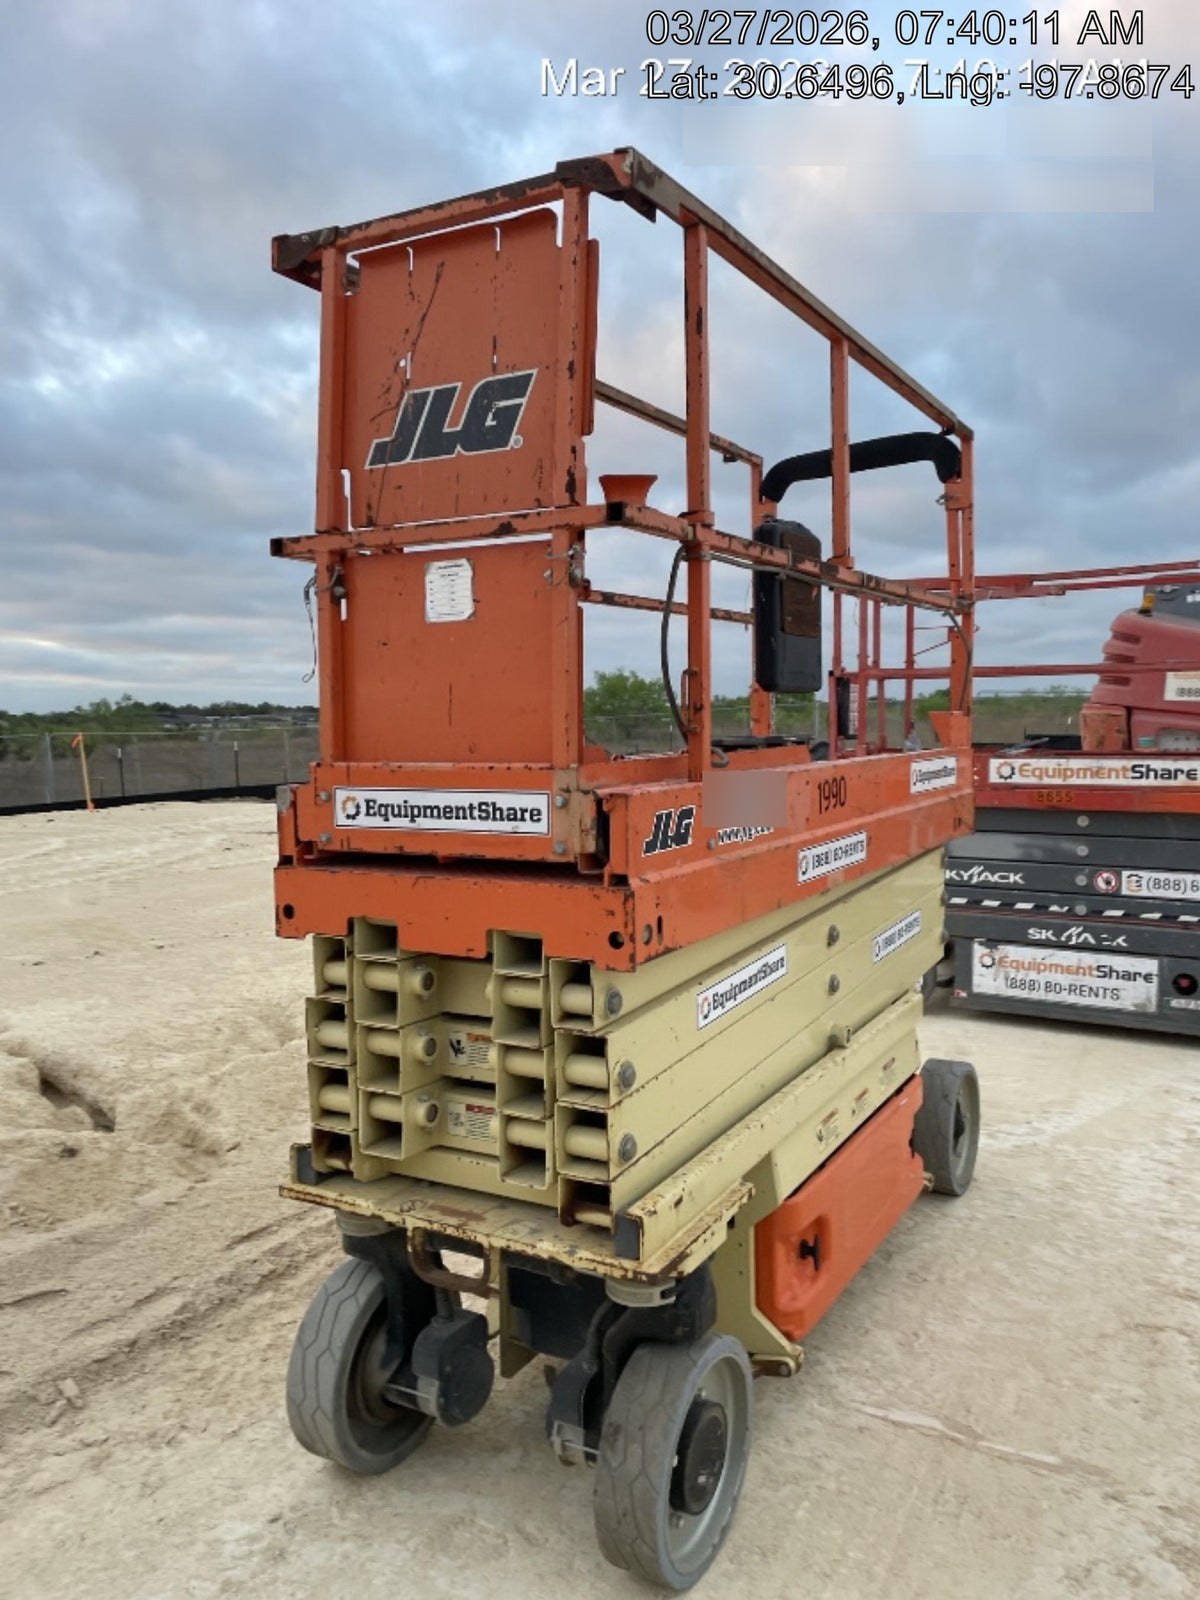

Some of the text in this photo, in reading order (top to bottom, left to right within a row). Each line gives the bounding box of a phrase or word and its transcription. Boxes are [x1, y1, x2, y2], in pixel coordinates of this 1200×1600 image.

[364, 368, 539, 470] JLG
[1018, 763, 1198, 782] EquipmentShare
[817, 775, 847, 815] 1990
[363, 798, 543, 823] EquipmentShare
[641, 804, 696, 857] JLG
[945, 865, 1025, 884] KYJACK
[1146, 875, 1187, 895] (888)
[712, 956, 785, 1010] EquipmentShare
[998, 955, 1155, 984] EquipmentShare
[1004, 976, 1121, 1000] (888) 80-RENTS
